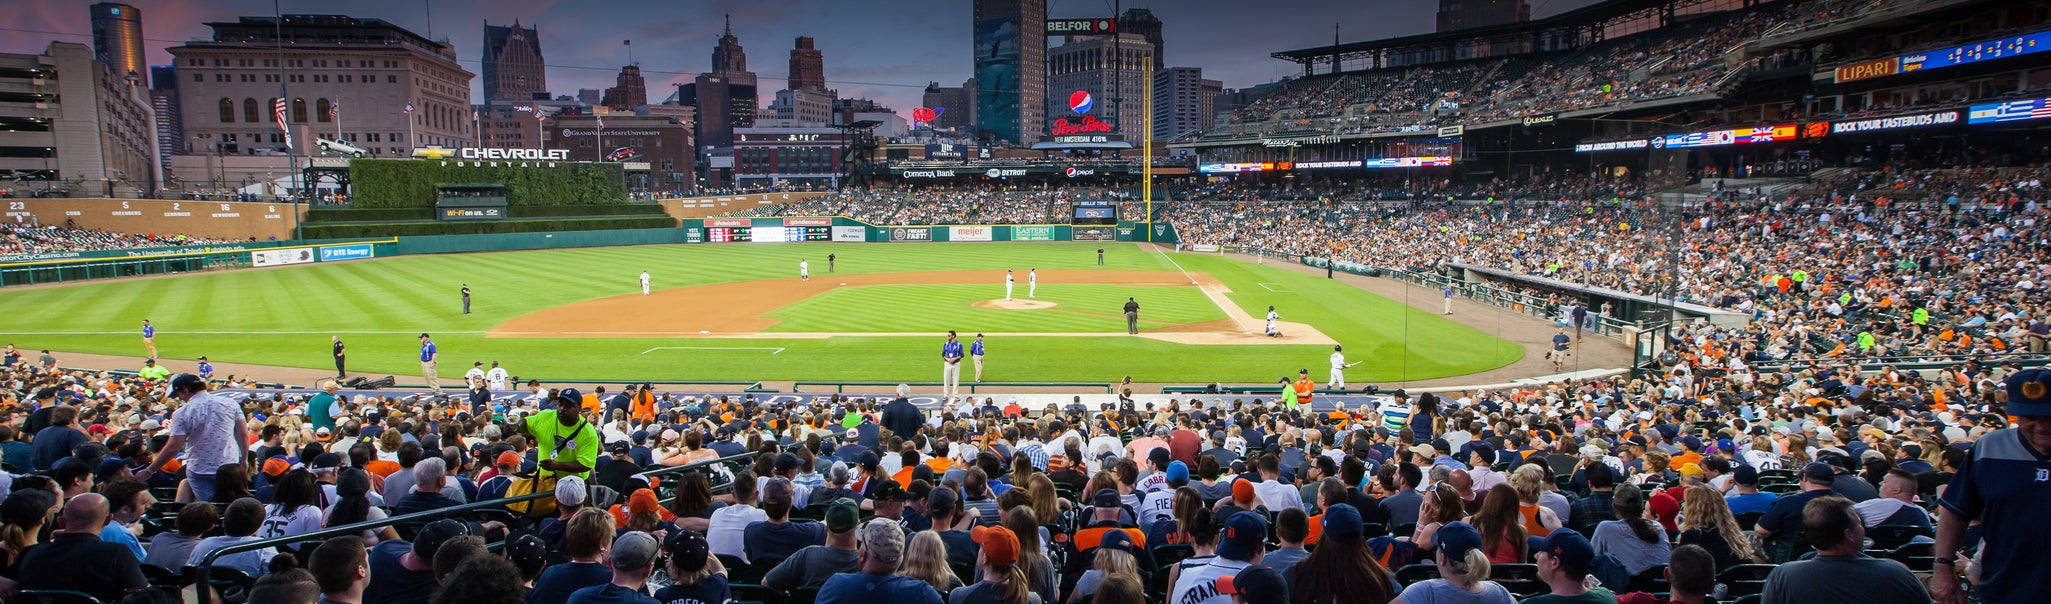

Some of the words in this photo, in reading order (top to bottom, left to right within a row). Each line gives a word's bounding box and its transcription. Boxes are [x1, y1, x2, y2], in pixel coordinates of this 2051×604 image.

[1047, 21, 1091, 31] BELFOR
[1842, 61, 1889, 80] LIPARI
[1531, 115, 1554, 124] LEXUS
[1834, 122, 1857, 133] ROCK
[1857, 119, 1882, 131] YOUR
[1882, 114, 1934, 129] TASTEBUDS
[1933, 111, 1959, 124] AND
[1579, 143, 1593, 152] FROM
[1593, 142, 1616, 151] AROUND
[1616, 141, 1627, 149] THE
[1627, 139, 1648, 148] WORLD
[461, 147, 570, 160] CHEVROLET
[936, 169, 955, 177] Bank
[10, 202, 25, 210] 23
[122, 201, 129, 209] 5
[173, 203, 180, 211] 2
[221, 203, 230, 212] 16
[269, 205, 275, 213] 6
[447, 209, 465, 217] Wi-Fi
[958, 227, 983, 237] meijer
[347, 248, 369, 256] Energy
[1155, 498, 1173, 510] FIE
[263, 521, 288, 539] 35
[1180, 579, 1222, 604] GRAN
